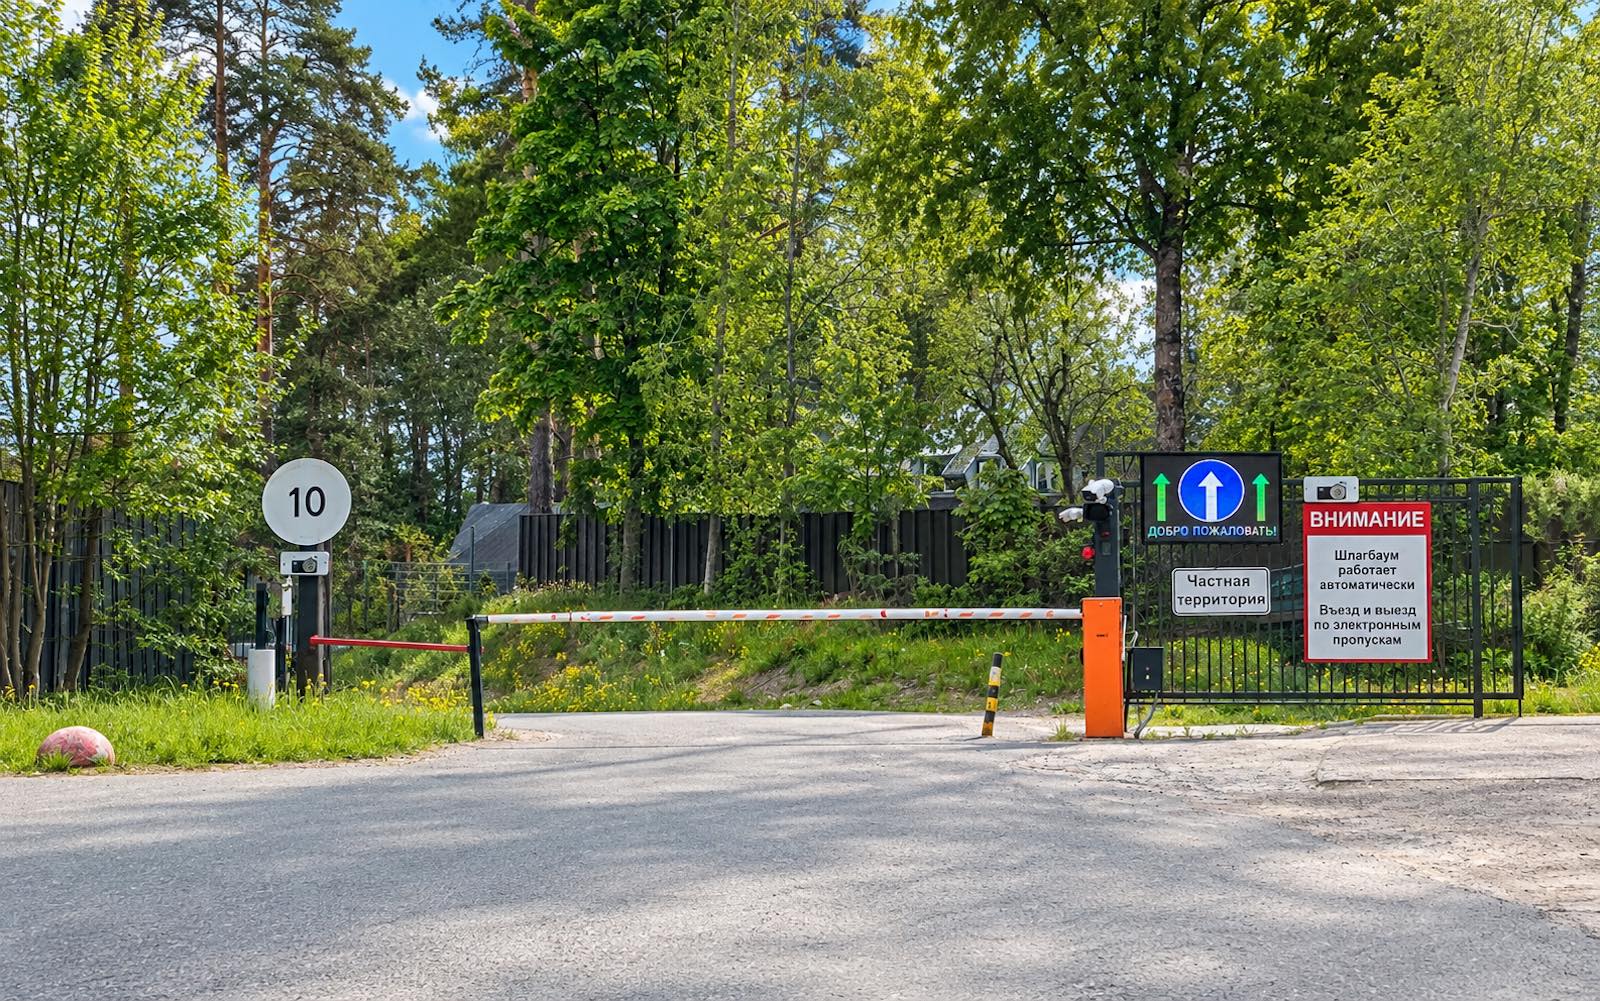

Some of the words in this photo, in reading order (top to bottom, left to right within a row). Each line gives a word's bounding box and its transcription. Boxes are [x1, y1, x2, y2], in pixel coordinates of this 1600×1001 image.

[289, 486, 326, 517] 10
[1310, 511, 1424, 527] ВНИМАНИЕ
[1148, 526, 1188, 537] ДОБРО
[1193, 526, 1277, 536] ПОЖАЛОВАТЬ!
[1335, 550, 1399, 562] Шлагбаум
[1338, 565, 1396, 577] работает
[1187, 575, 1250, 587] Частная
[1320, 581, 1414, 589] автоматически
[1177, 595, 1265, 608] территория
[1320, 605, 1360, 616] Въезд
[1364, 607, 1371, 615] и
[1375, 607, 1416, 616] выезд
[1314, 622, 1329, 630] по
[1333, 636, 1401, 647] пропускам
